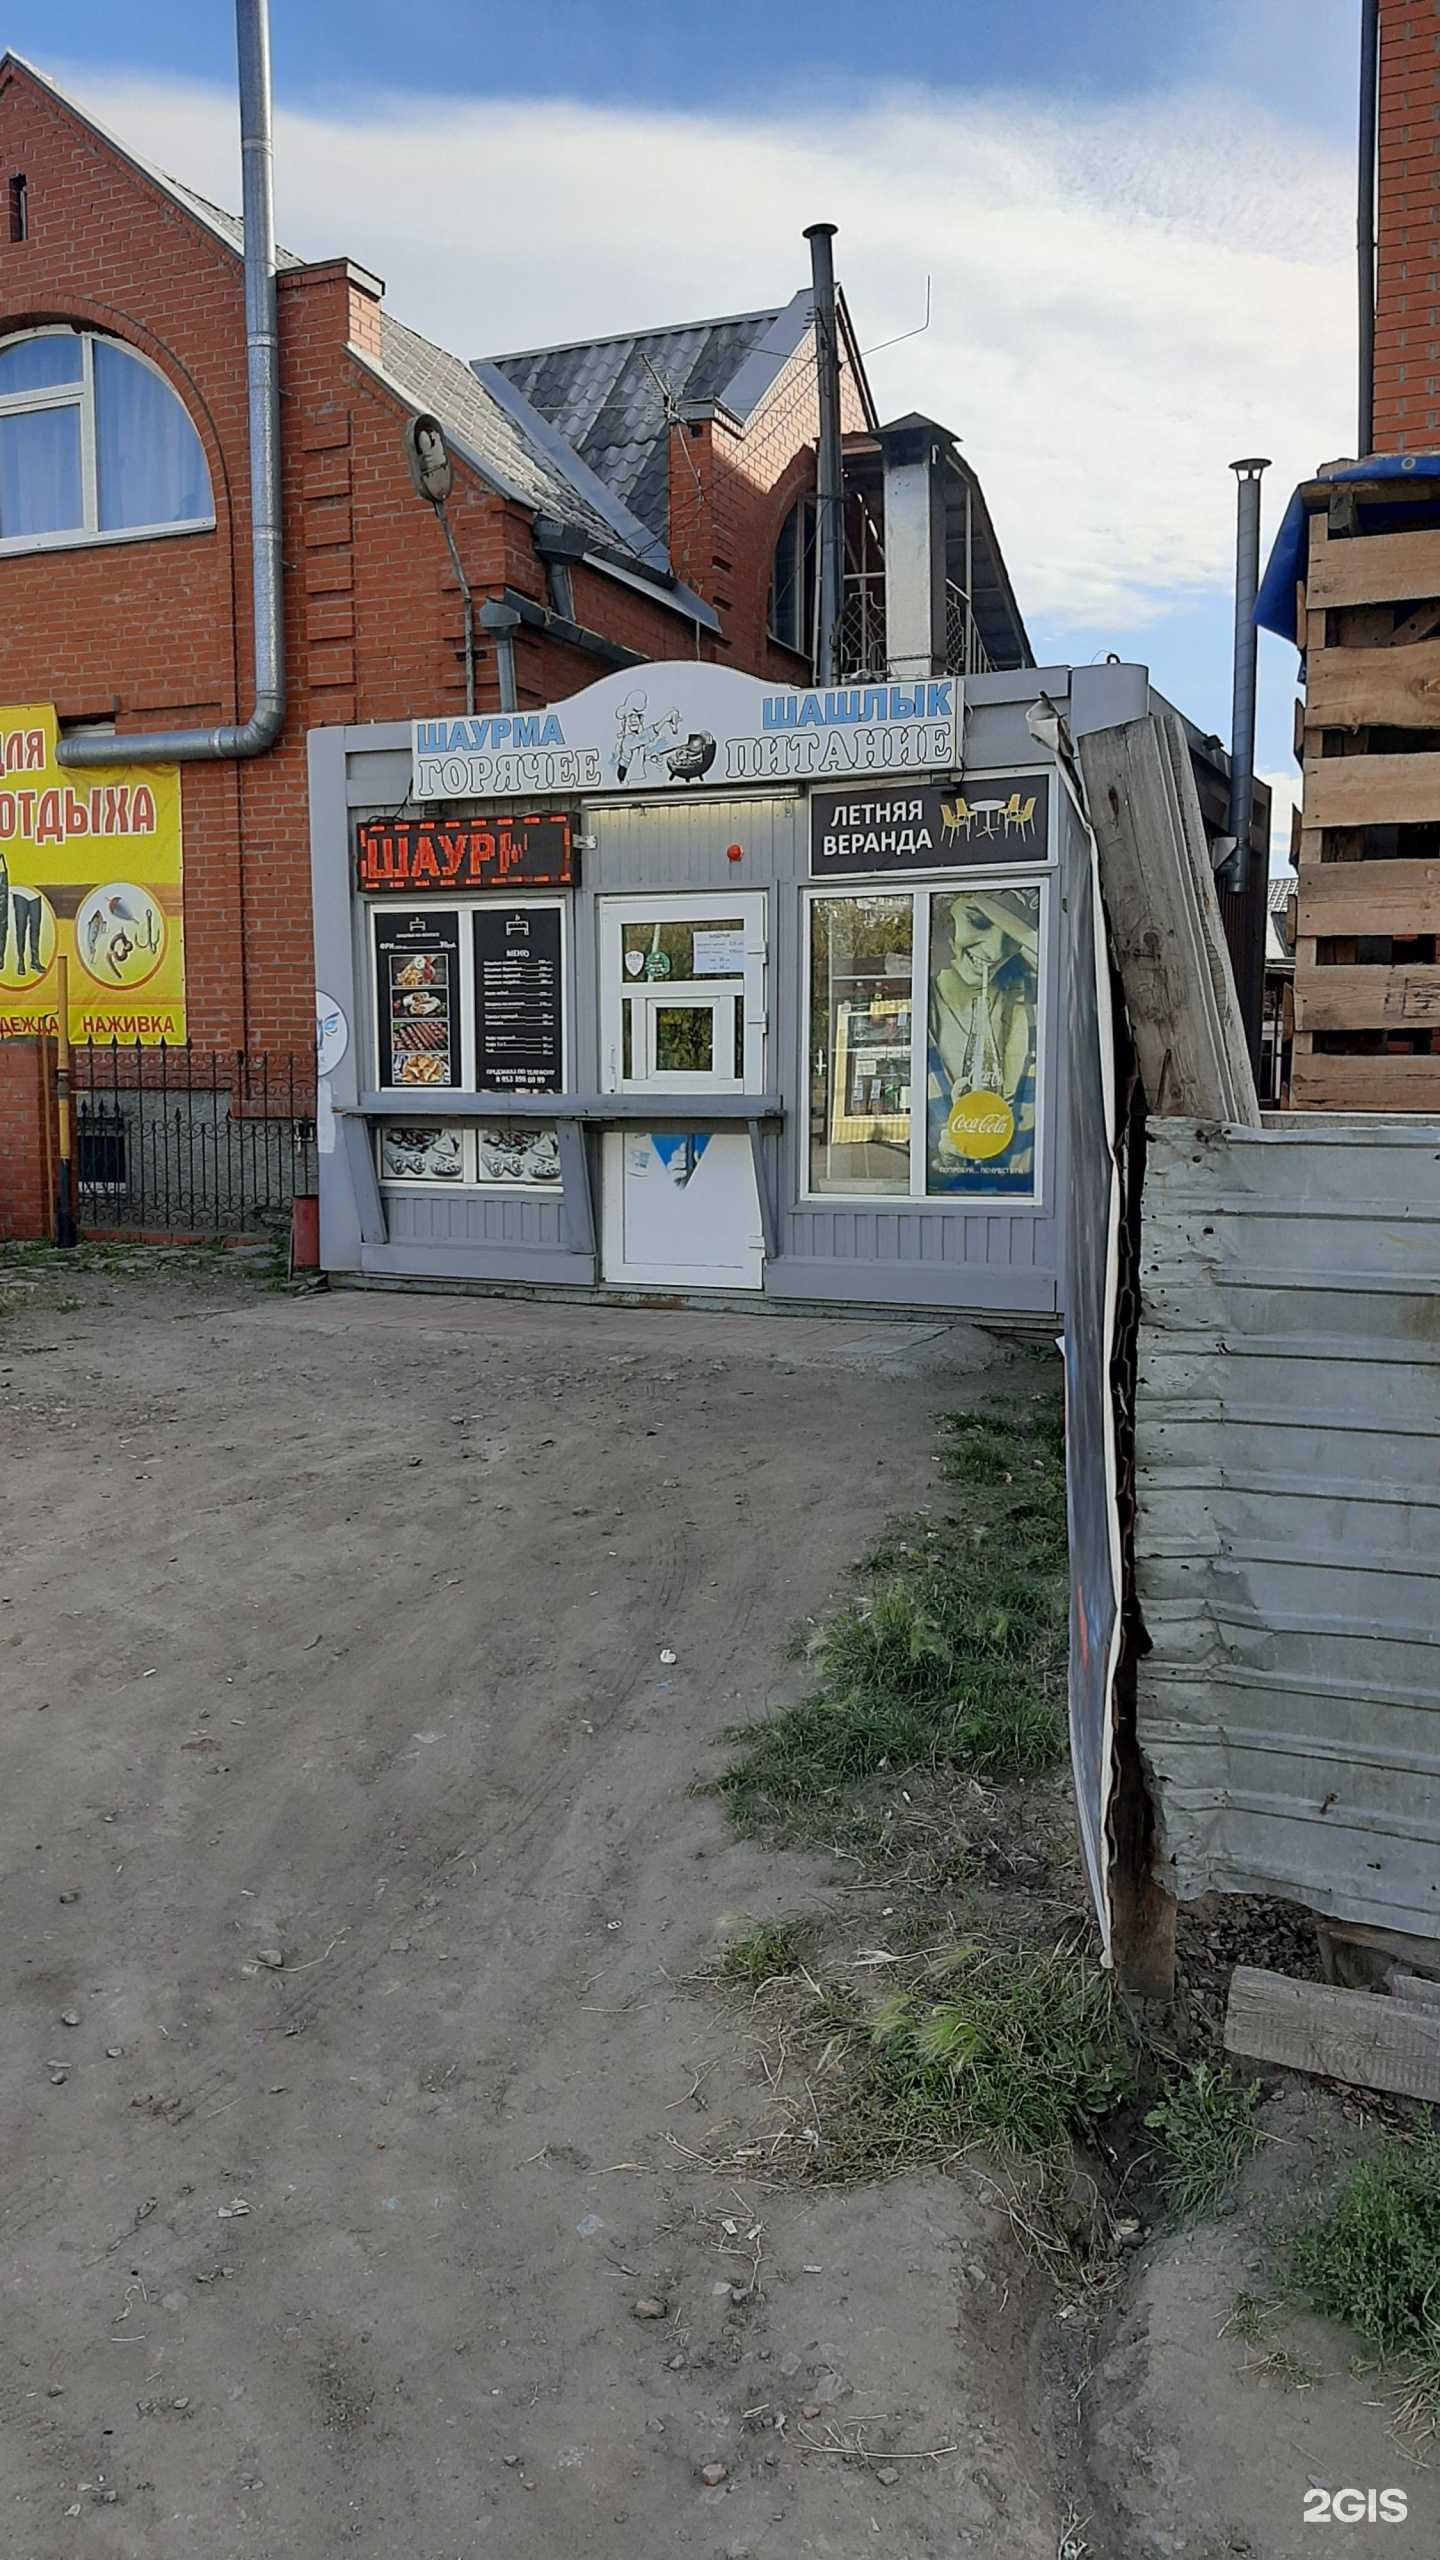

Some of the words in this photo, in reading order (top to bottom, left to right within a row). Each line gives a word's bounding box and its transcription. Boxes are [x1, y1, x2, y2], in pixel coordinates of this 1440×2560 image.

[763, 682, 952, 730] ШАШЛЫК
[0, 728, 46, 779] ЛЯ
[418, 714, 566, 754] ШАУРМА
[418, 749, 601, 796] ГОРЯЧЕЕ
[725, 722, 952, 778] ПИТАНИЕ
[0, 784, 157, 845] ОТДЫХА
[830, 800, 923, 828] ЛЕТНЯЯ
[823, 828, 933, 856] ВЕРАНДА
[83, 1015, 175, 1033] НАЖИВКА
